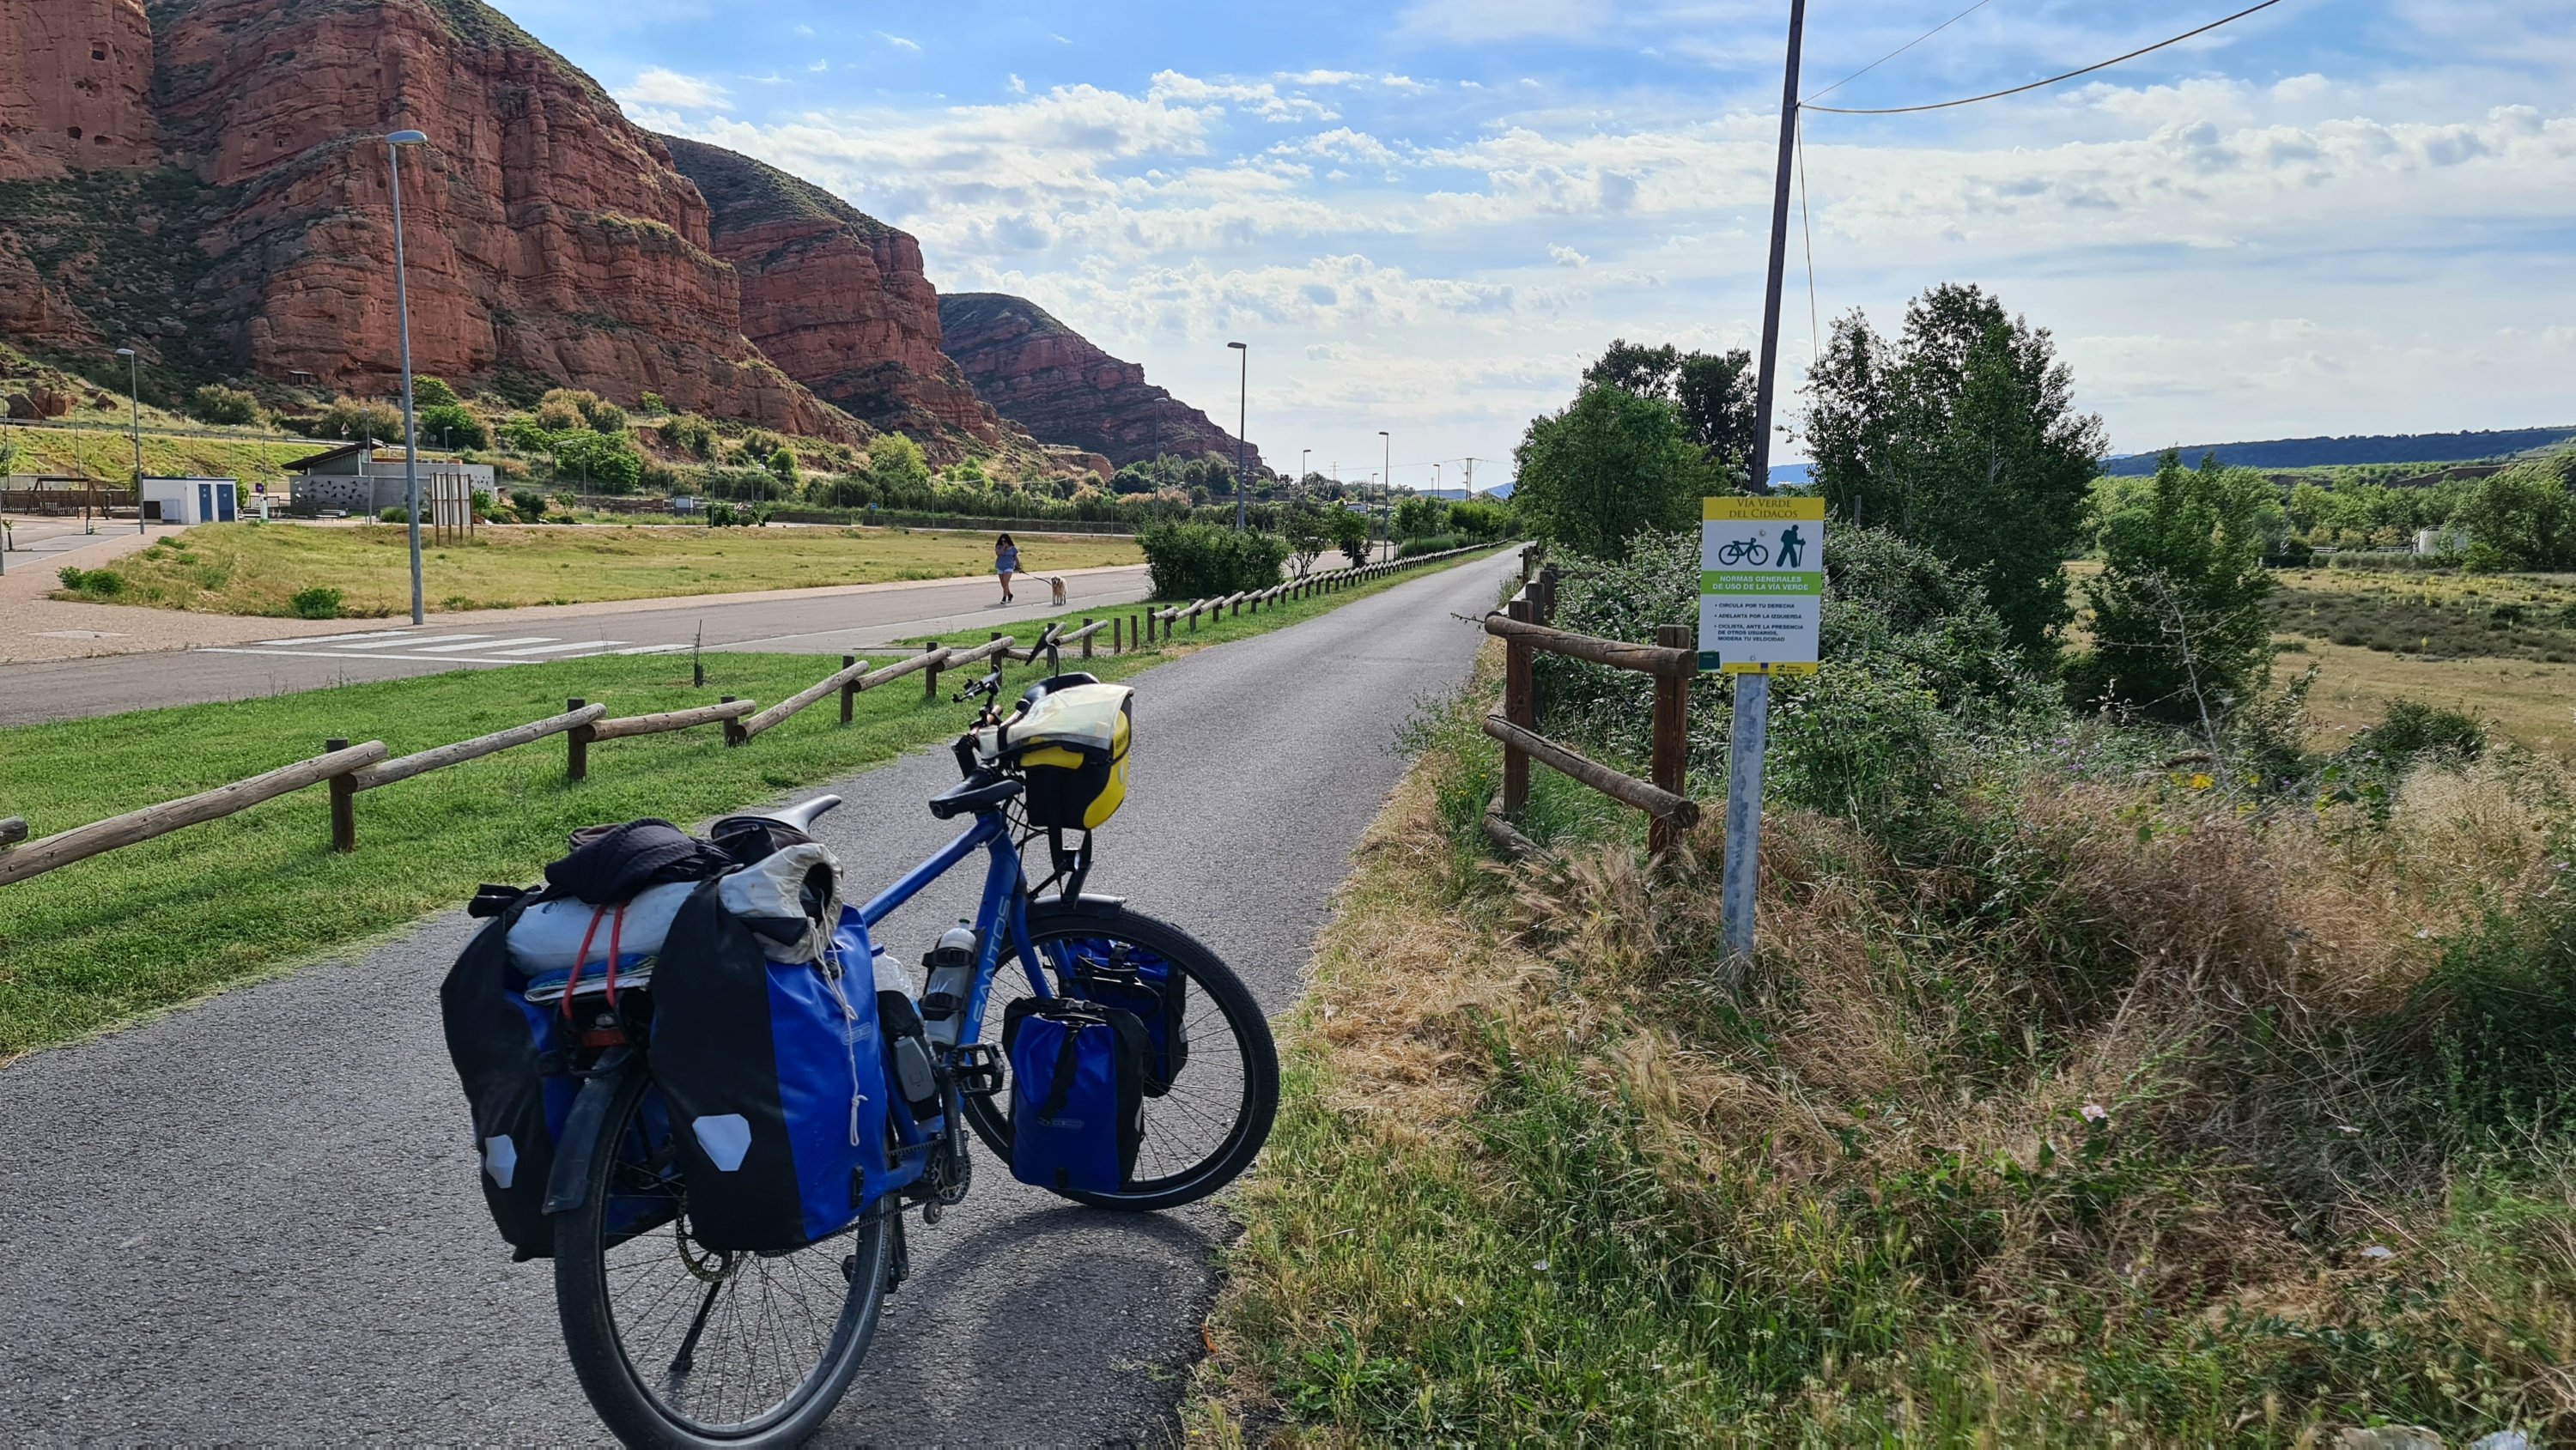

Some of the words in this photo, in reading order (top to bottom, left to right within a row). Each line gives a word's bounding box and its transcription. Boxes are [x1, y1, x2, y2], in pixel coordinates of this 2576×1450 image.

[1758, 498, 1791, 508] VERDE
[1729, 510, 1747, 519] DEL
[1751, 508, 1798, 519] CIDACOS
[973, 895, 1011, 1023] SANTOS
